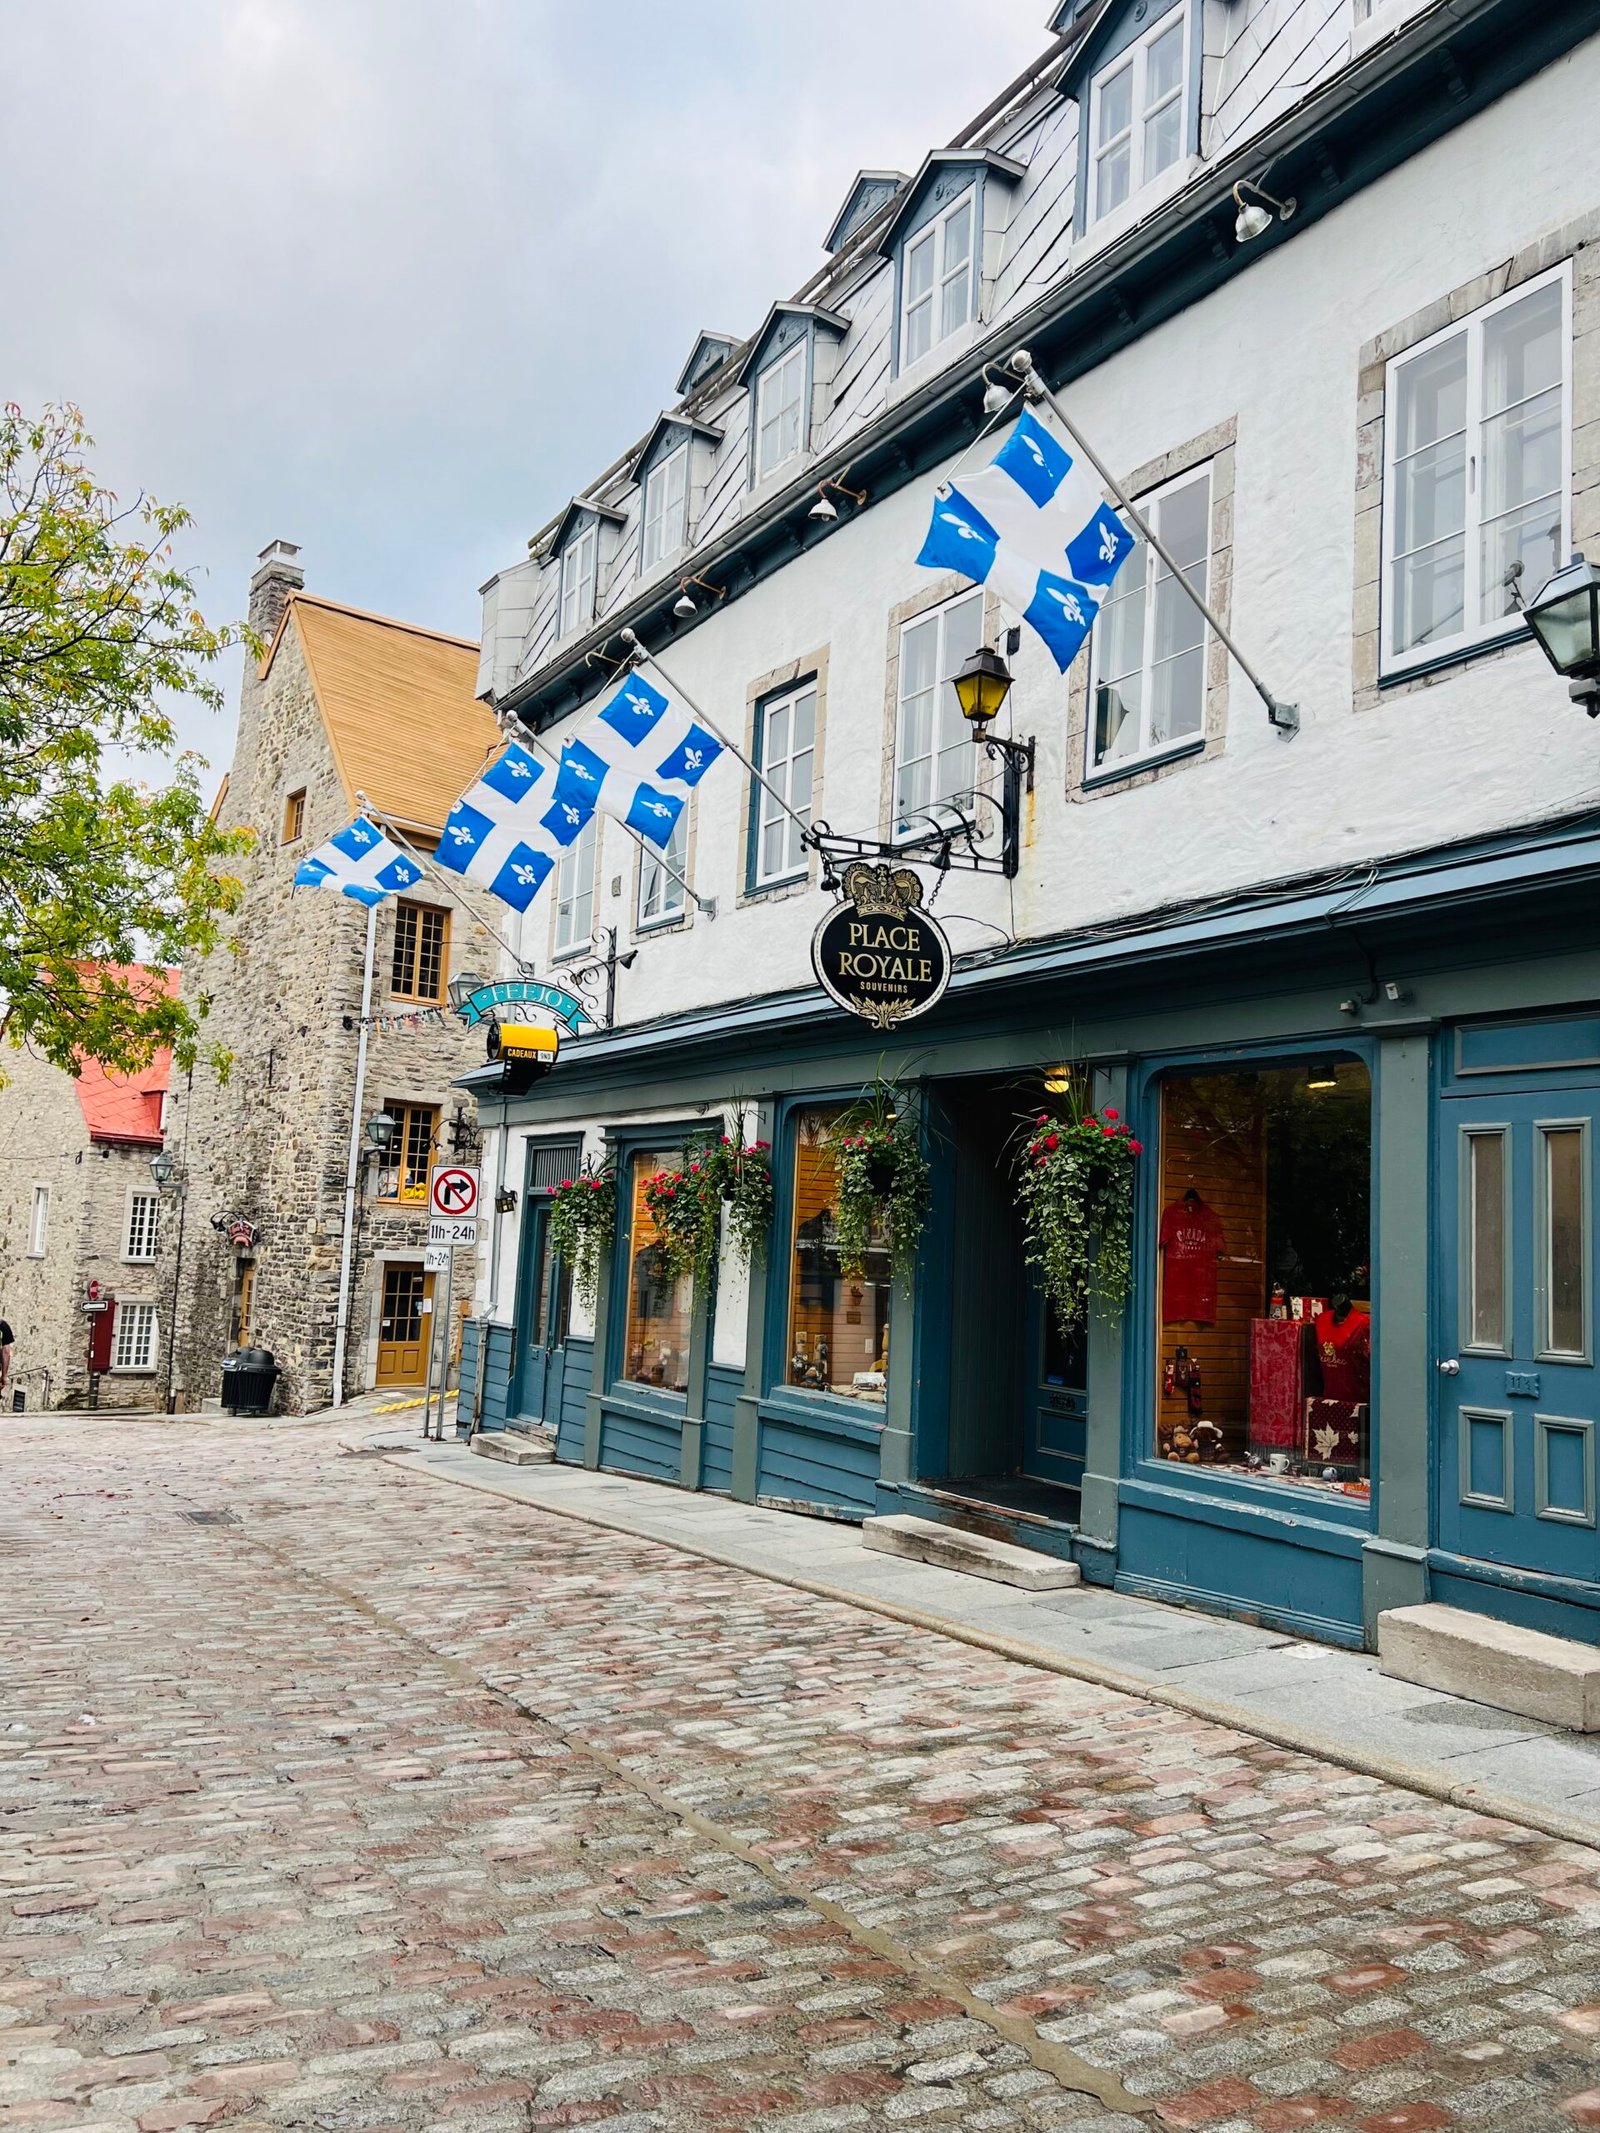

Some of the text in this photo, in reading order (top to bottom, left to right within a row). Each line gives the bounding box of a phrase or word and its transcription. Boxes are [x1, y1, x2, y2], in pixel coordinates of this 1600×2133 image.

[848, 922, 920, 951] PLACE
[838, 951, 932, 982] ROYALE
[490, 982, 563, 1007] FEEJO
[860, 981, 908, 994] SOUVENIRS
[507, 1048, 537, 1060] CADEAUX
[431, 1225, 475, 1240] 11h-24h
